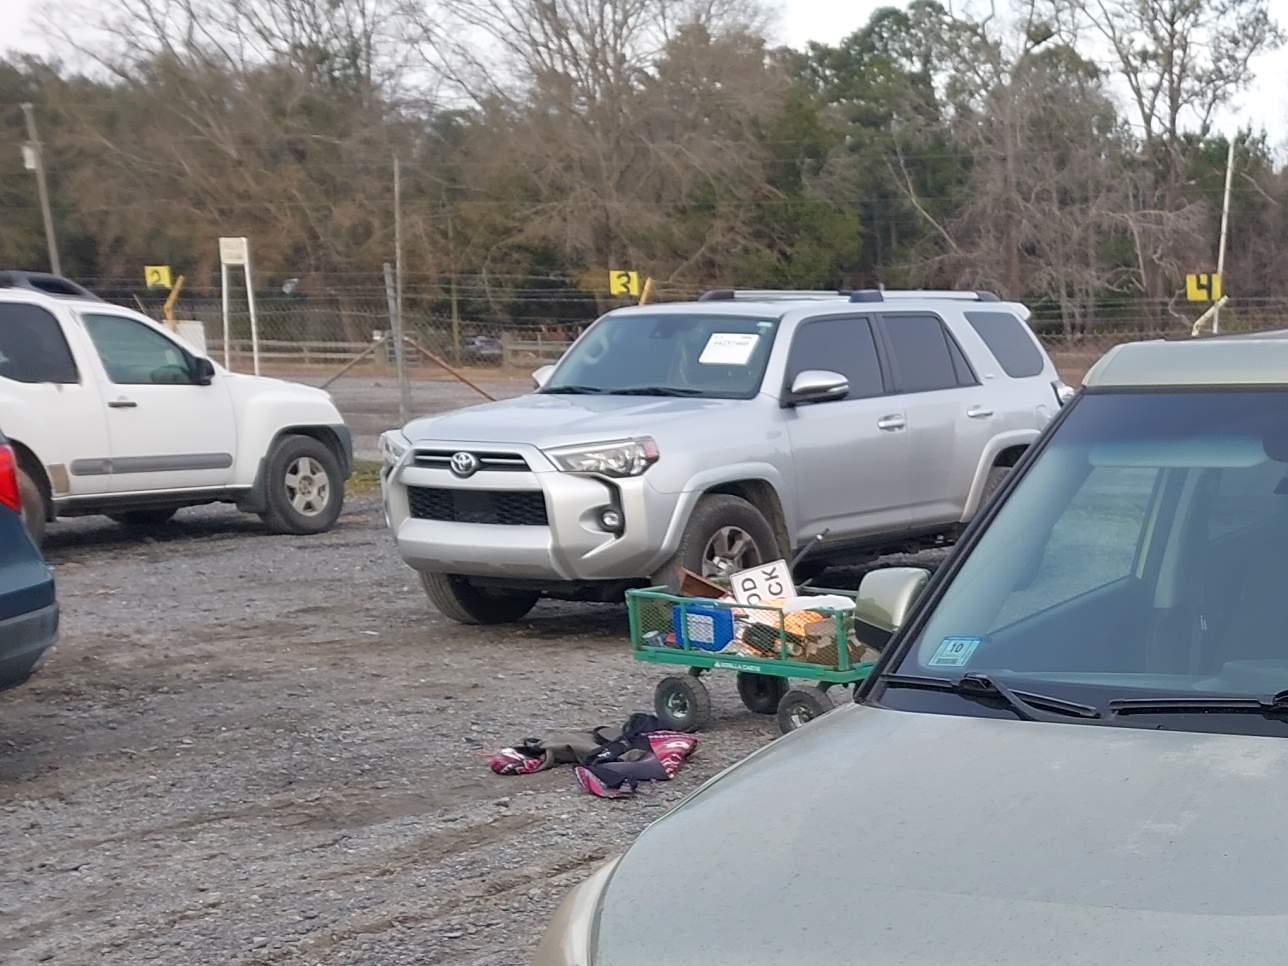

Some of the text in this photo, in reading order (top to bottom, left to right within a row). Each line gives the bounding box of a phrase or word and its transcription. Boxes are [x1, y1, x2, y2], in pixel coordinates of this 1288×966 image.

[616, 271, 631, 294] 3
[1196, 273, 1212, 300] 4
[761, 566, 783, 599] CK
